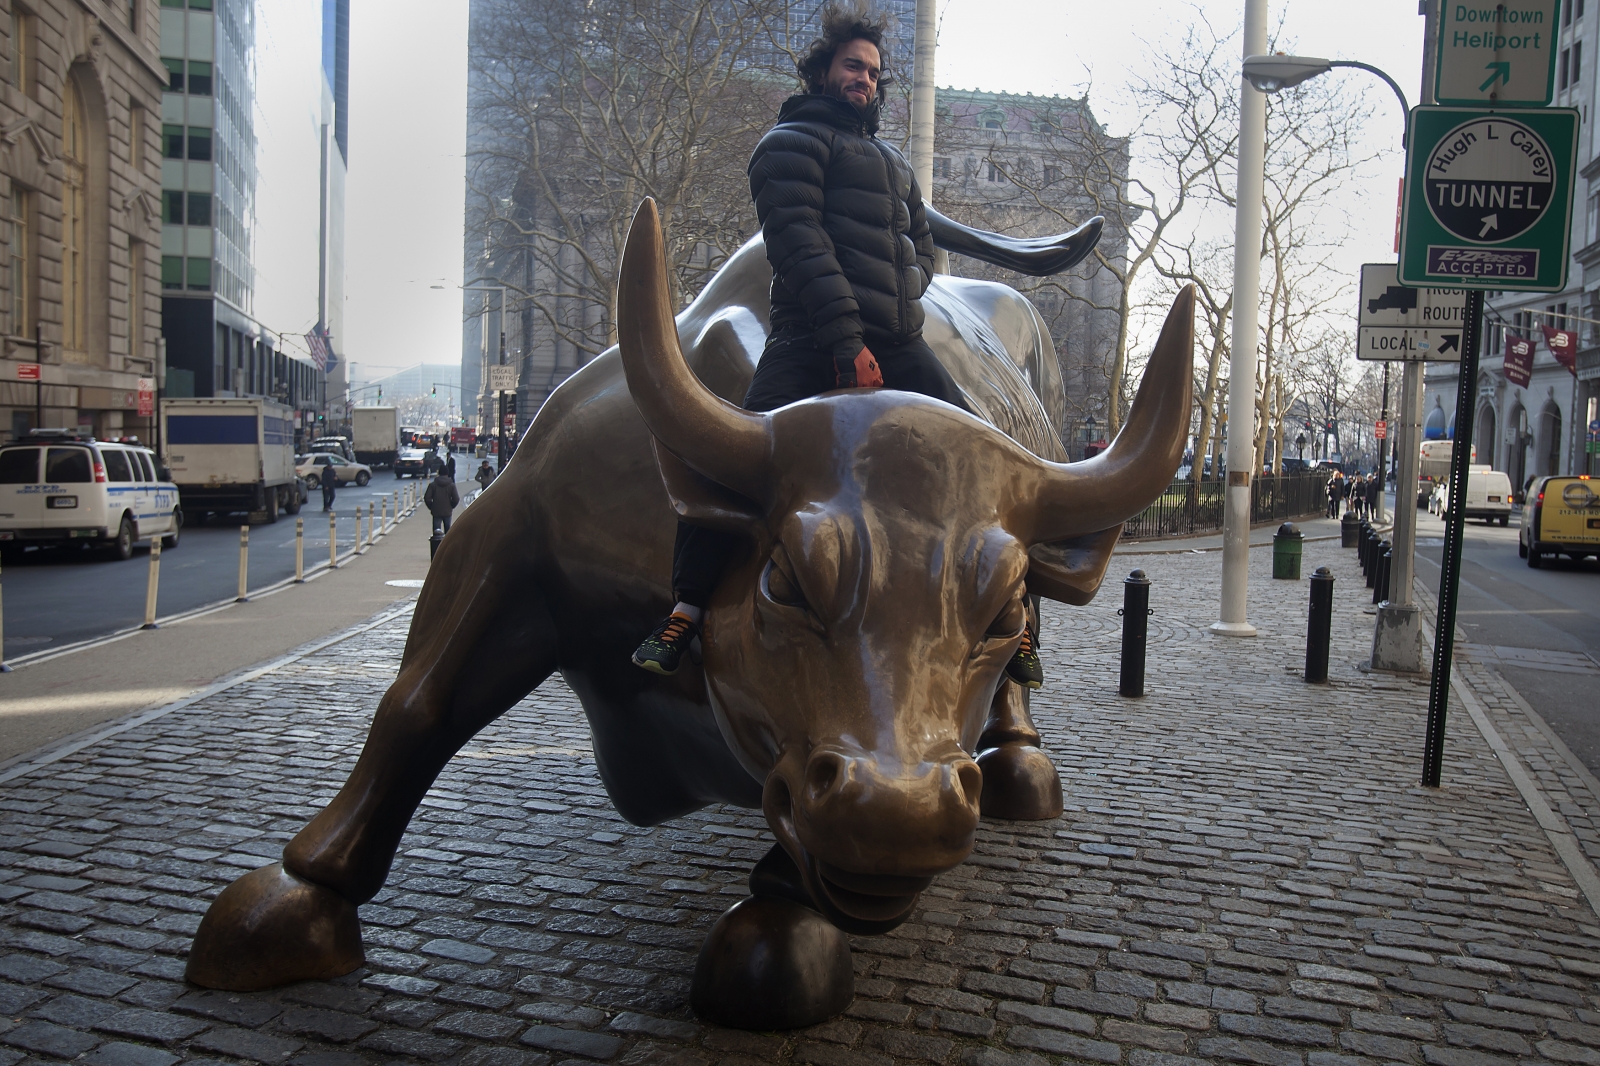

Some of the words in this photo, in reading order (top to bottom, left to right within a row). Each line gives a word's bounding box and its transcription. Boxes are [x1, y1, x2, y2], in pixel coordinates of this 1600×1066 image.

[1455, 5, 1543, 23] Downtown
[1453, 31, 1541, 52] Heliport
[1432, 131, 1477, 173] Hugh
[1487, 124, 1499, 140] L
[1510, 130, 1549, 177] Carey
[1436, 183, 1540, 210] TUNNEL
[1437, 261, 1527, 275] ACCEPTED
[1371, 336, 1417, 351] LOCAL
